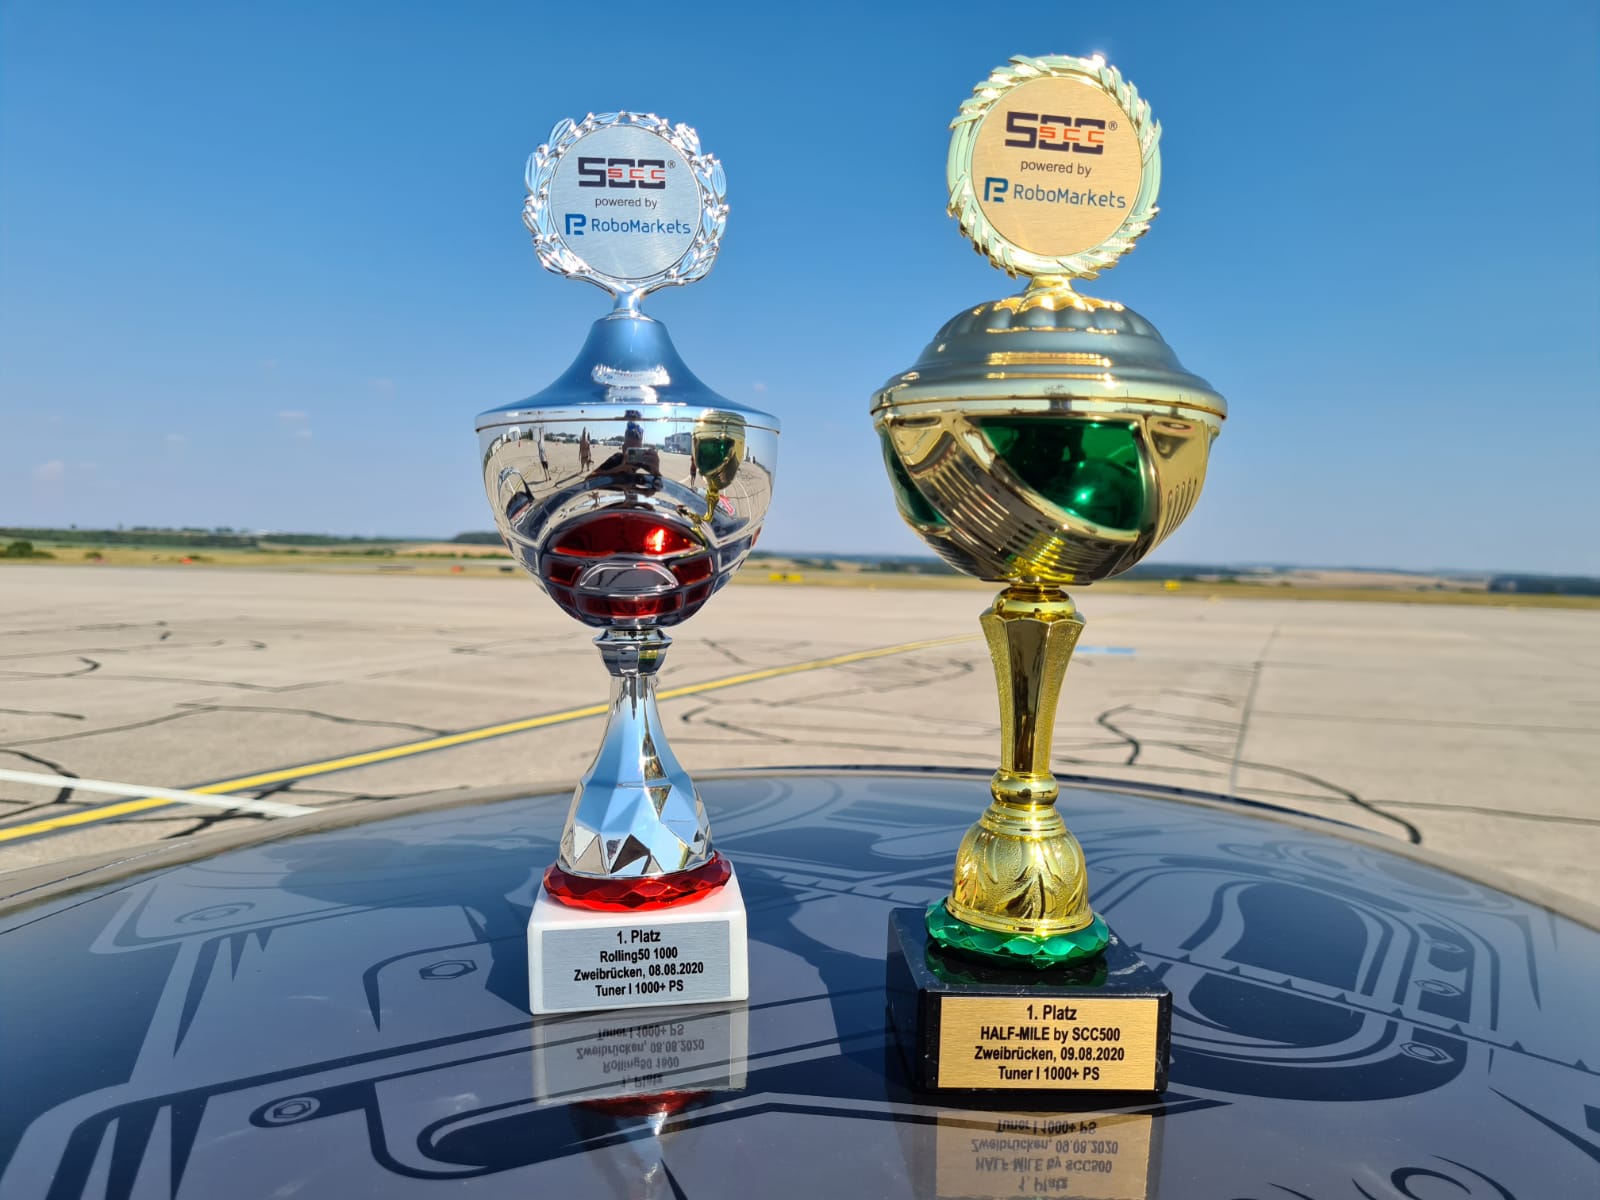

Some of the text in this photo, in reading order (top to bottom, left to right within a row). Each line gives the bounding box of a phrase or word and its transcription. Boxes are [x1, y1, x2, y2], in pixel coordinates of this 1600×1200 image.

[1020, 160, 1091, 177] powered by
[595, 197, 657, 209] powered by
[1014, 184, 1126, 208] RoboMarkets
[591, 217, 691, 234] RoboMarkets
[616, 929, 661, 944] 1. Platz
[600, 946, 678, 964] Rolling50 1000
[574, 962, 704, 982] Zweibrücken, 08.08.2020
[595, 983, 626, 997] Tuner
[635, 981, 666, 994] 1000+
[669, 980, 684, 992] PS
[1027, 1004, 1077, 1021] 1. Platz
[980, 1026, 1120, 1044] HALF-MILE by SCC500
[975, 1046, 1125, 1062] Zweibrücken, 09.08.2020
[998, 1066, 1033, 1080] Tuner
[1044, 1066, 1079, 1080] 1000+
[1083, 1067, 1100, 1081] PS
